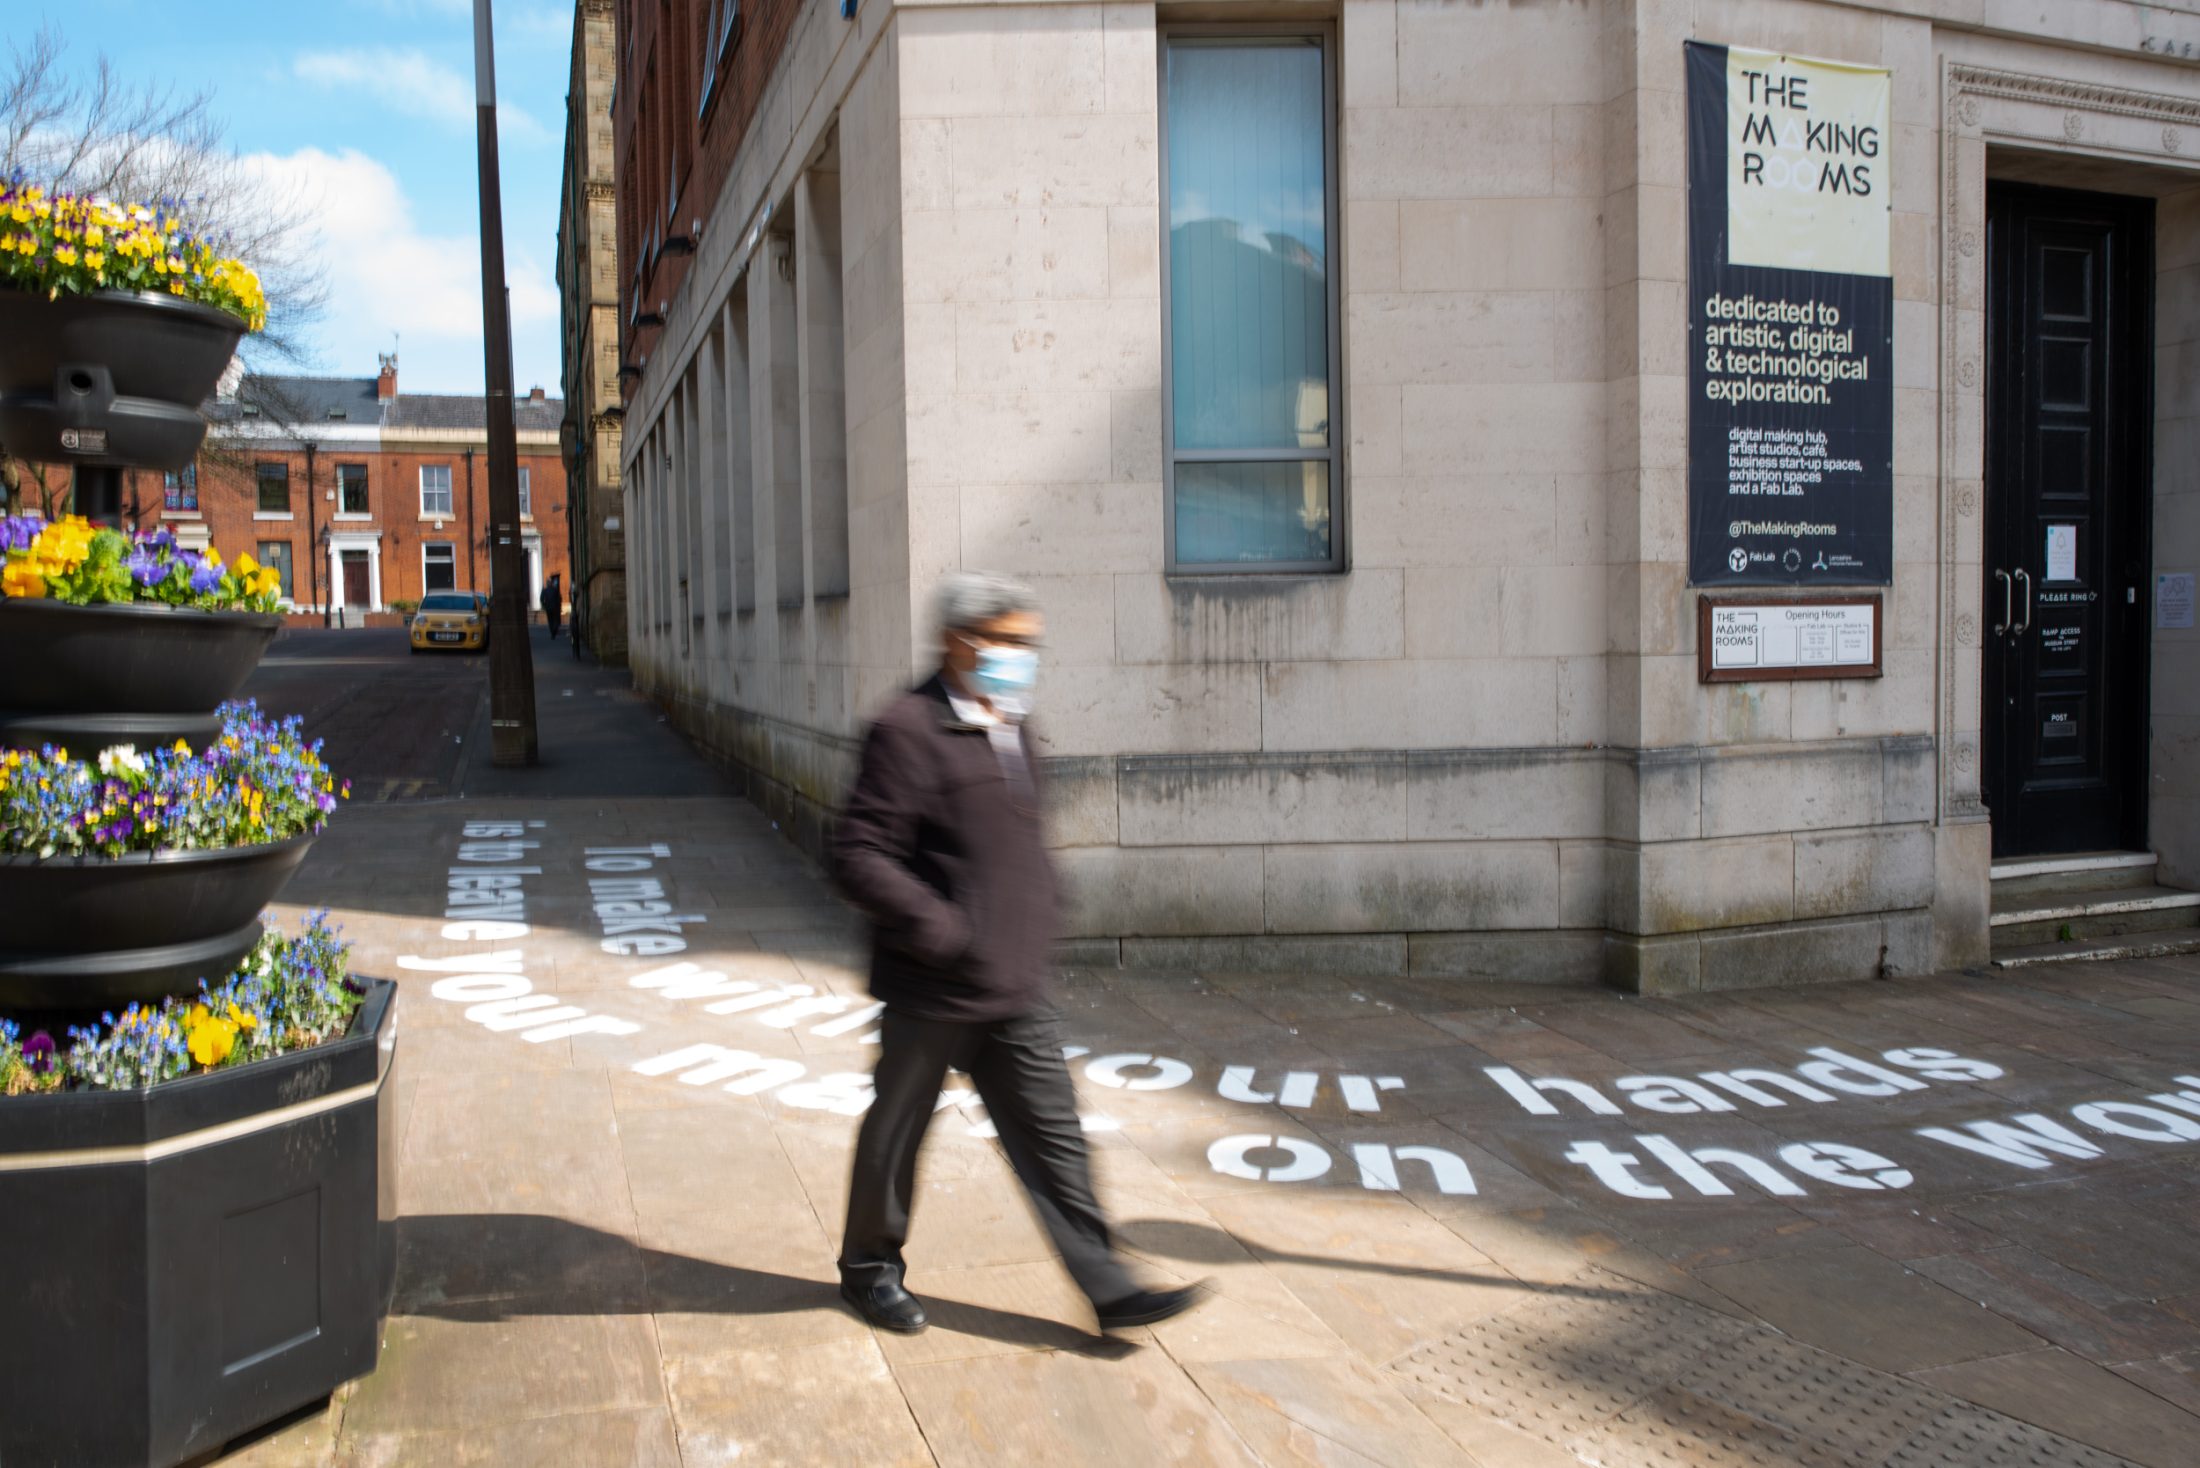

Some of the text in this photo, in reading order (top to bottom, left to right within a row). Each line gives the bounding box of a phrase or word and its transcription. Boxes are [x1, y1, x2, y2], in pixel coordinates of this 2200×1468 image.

[1742, 70, 1808, 111] THE
[1705, 292, 1840, 326] dedicated to
[1705, 322, 1853, 357] artistic, digital
[1705, 347, 1868, 384] & technological
[1705, 376, 1831, 406] exploration.
[1729, 426, 1828, 445] digital making hub,
[1729, 441, 1758, 455] artist
[1759, 443, 1801, 457] studios,
[1729, 455, 1863, 473] business start-up spaces,
[1729, 468, 1822, 484] exhibition spaces
[1729, 482, 1804, 496] and a Fab Lab.
[1729, 520, 1837, 538] @TheMakingRooms
[2040, 592, 2068, 601] PLEASE
[1716, 613, 1736, 623] THE
[1785, 610, 1846, 621] Opening Hours
[1715, 624, 1758, 635] MAKING
[1715, 636, 1754, 647] ROOMS
[2051, 713, 2067, 722] POST
[462, 820, 546, 837] is
[457, 841, 541, 862] to
[440, 866, 543, 941] leave
[396, 949, 642, 1044] your
[588, 877, 707, 956] make
[1062, 1046, 1405, 1112] our
[1483, 1046, 2004, 1115] hands
[1206, 1134, 1478, 1195] on
[1564, 1134, 1914, 1200] the
